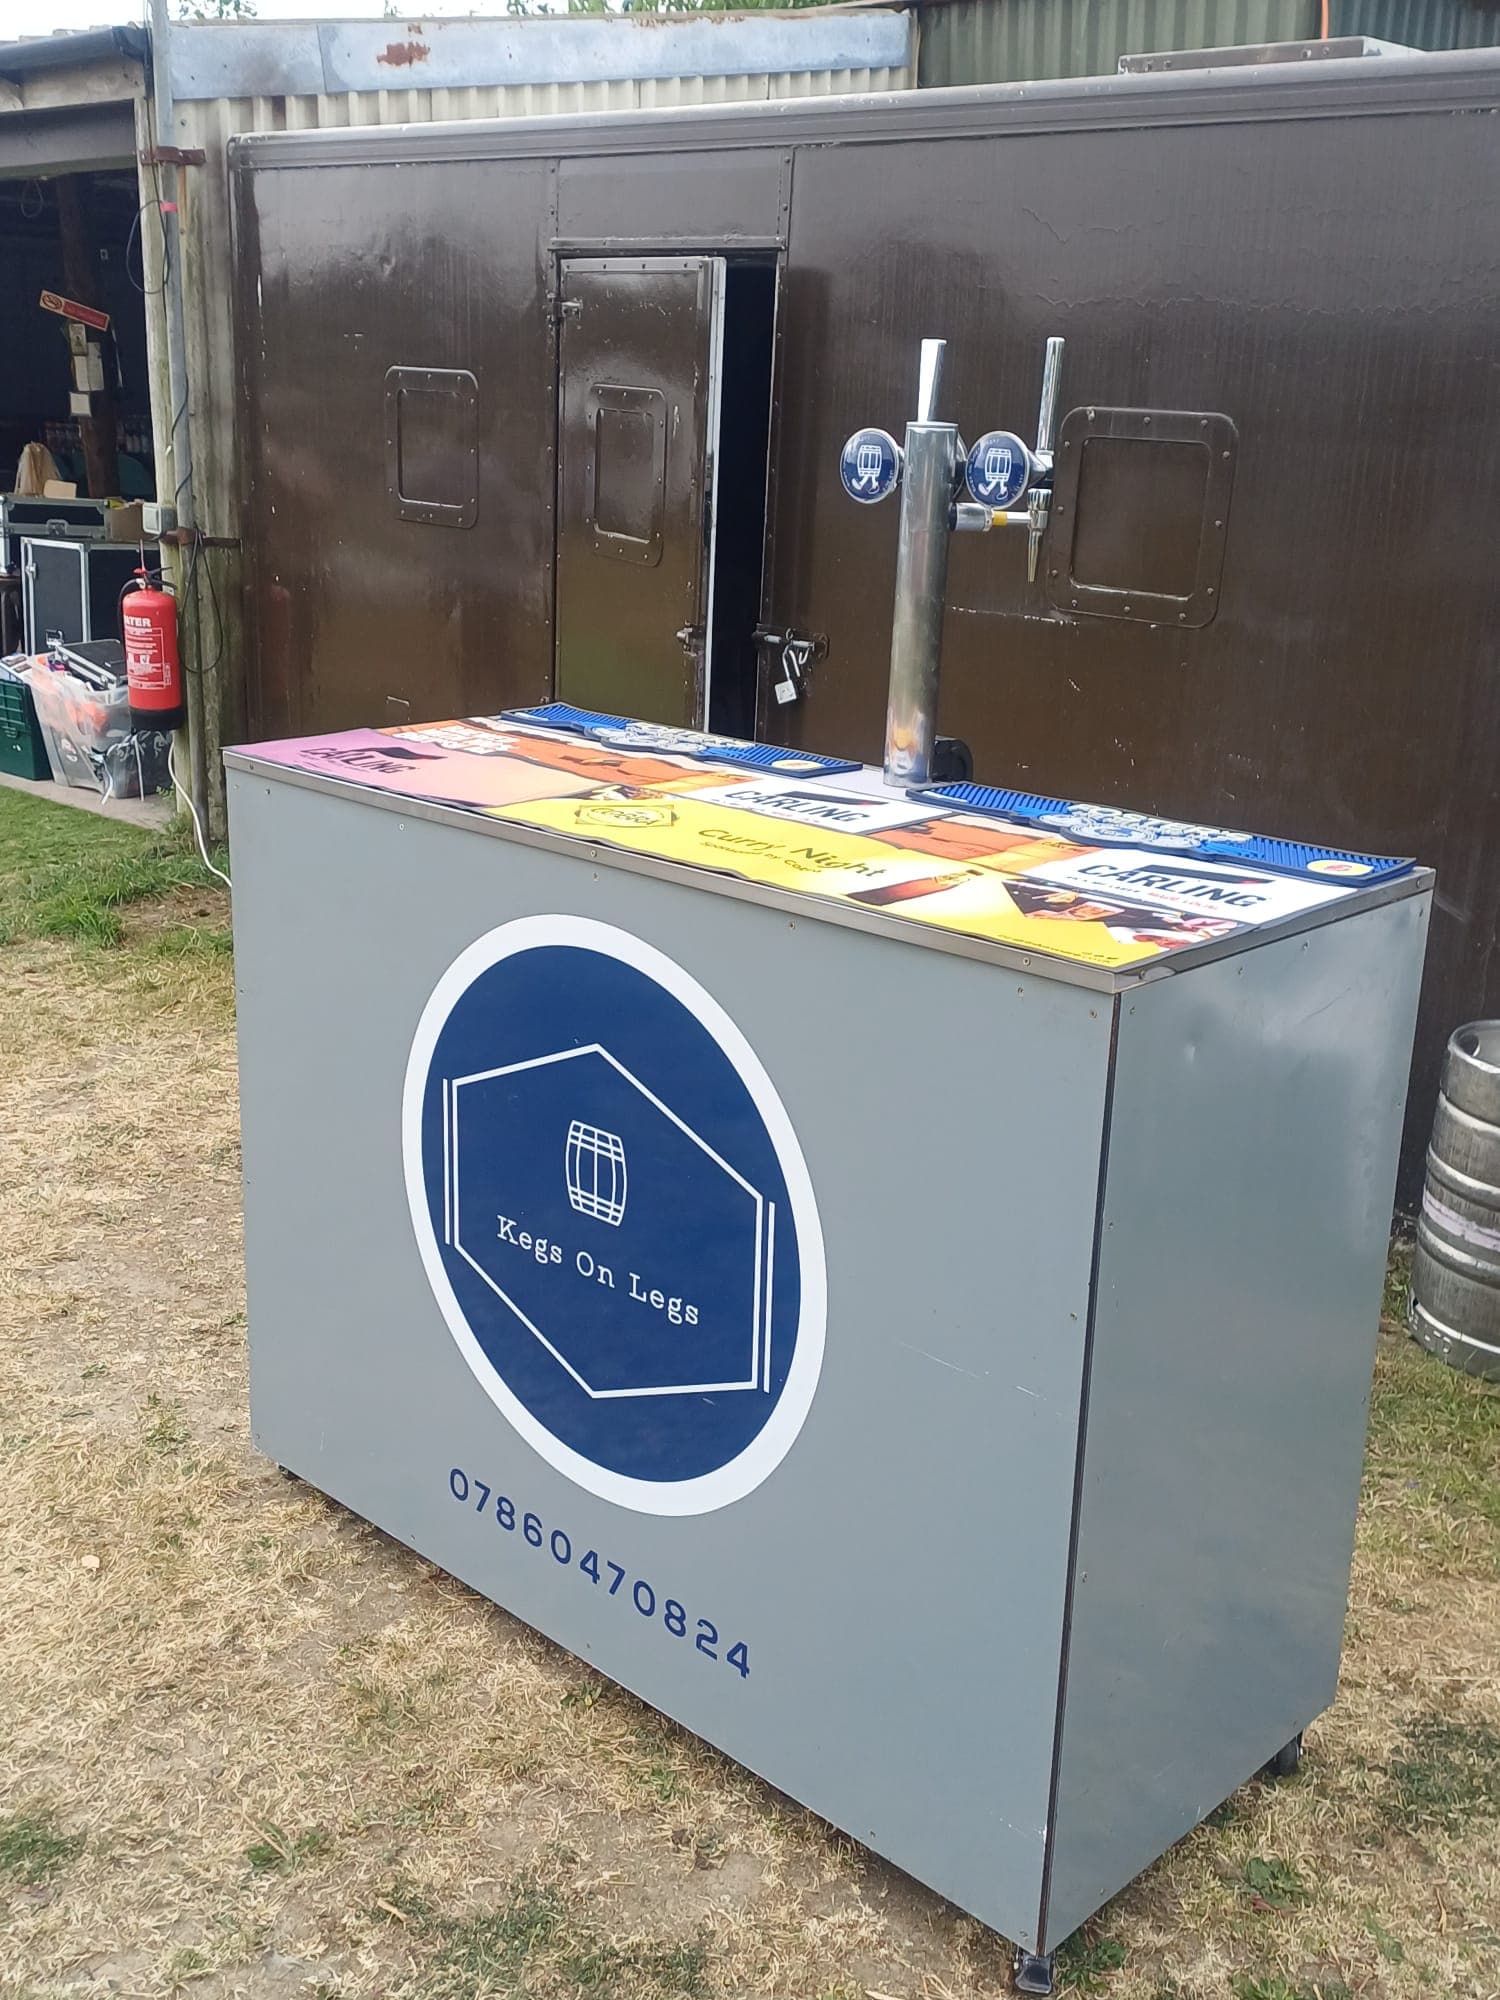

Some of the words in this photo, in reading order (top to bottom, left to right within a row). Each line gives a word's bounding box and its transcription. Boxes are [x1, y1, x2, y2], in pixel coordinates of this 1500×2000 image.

[124, 614, 151, 627] ATER
[725, 789, 870, 822] CARLING
[698, 829, 786, 851] Curry
[790, 846, 887, 877] Night
[1077, 864, 1267, 907] CARLING
[497, 1214, 562, 1264] Kegs
[576, 1251, 615, 1289] On
[629, 1272, 699, 1326] Legs
[449, 1467, 750, 1679] 07860470824
